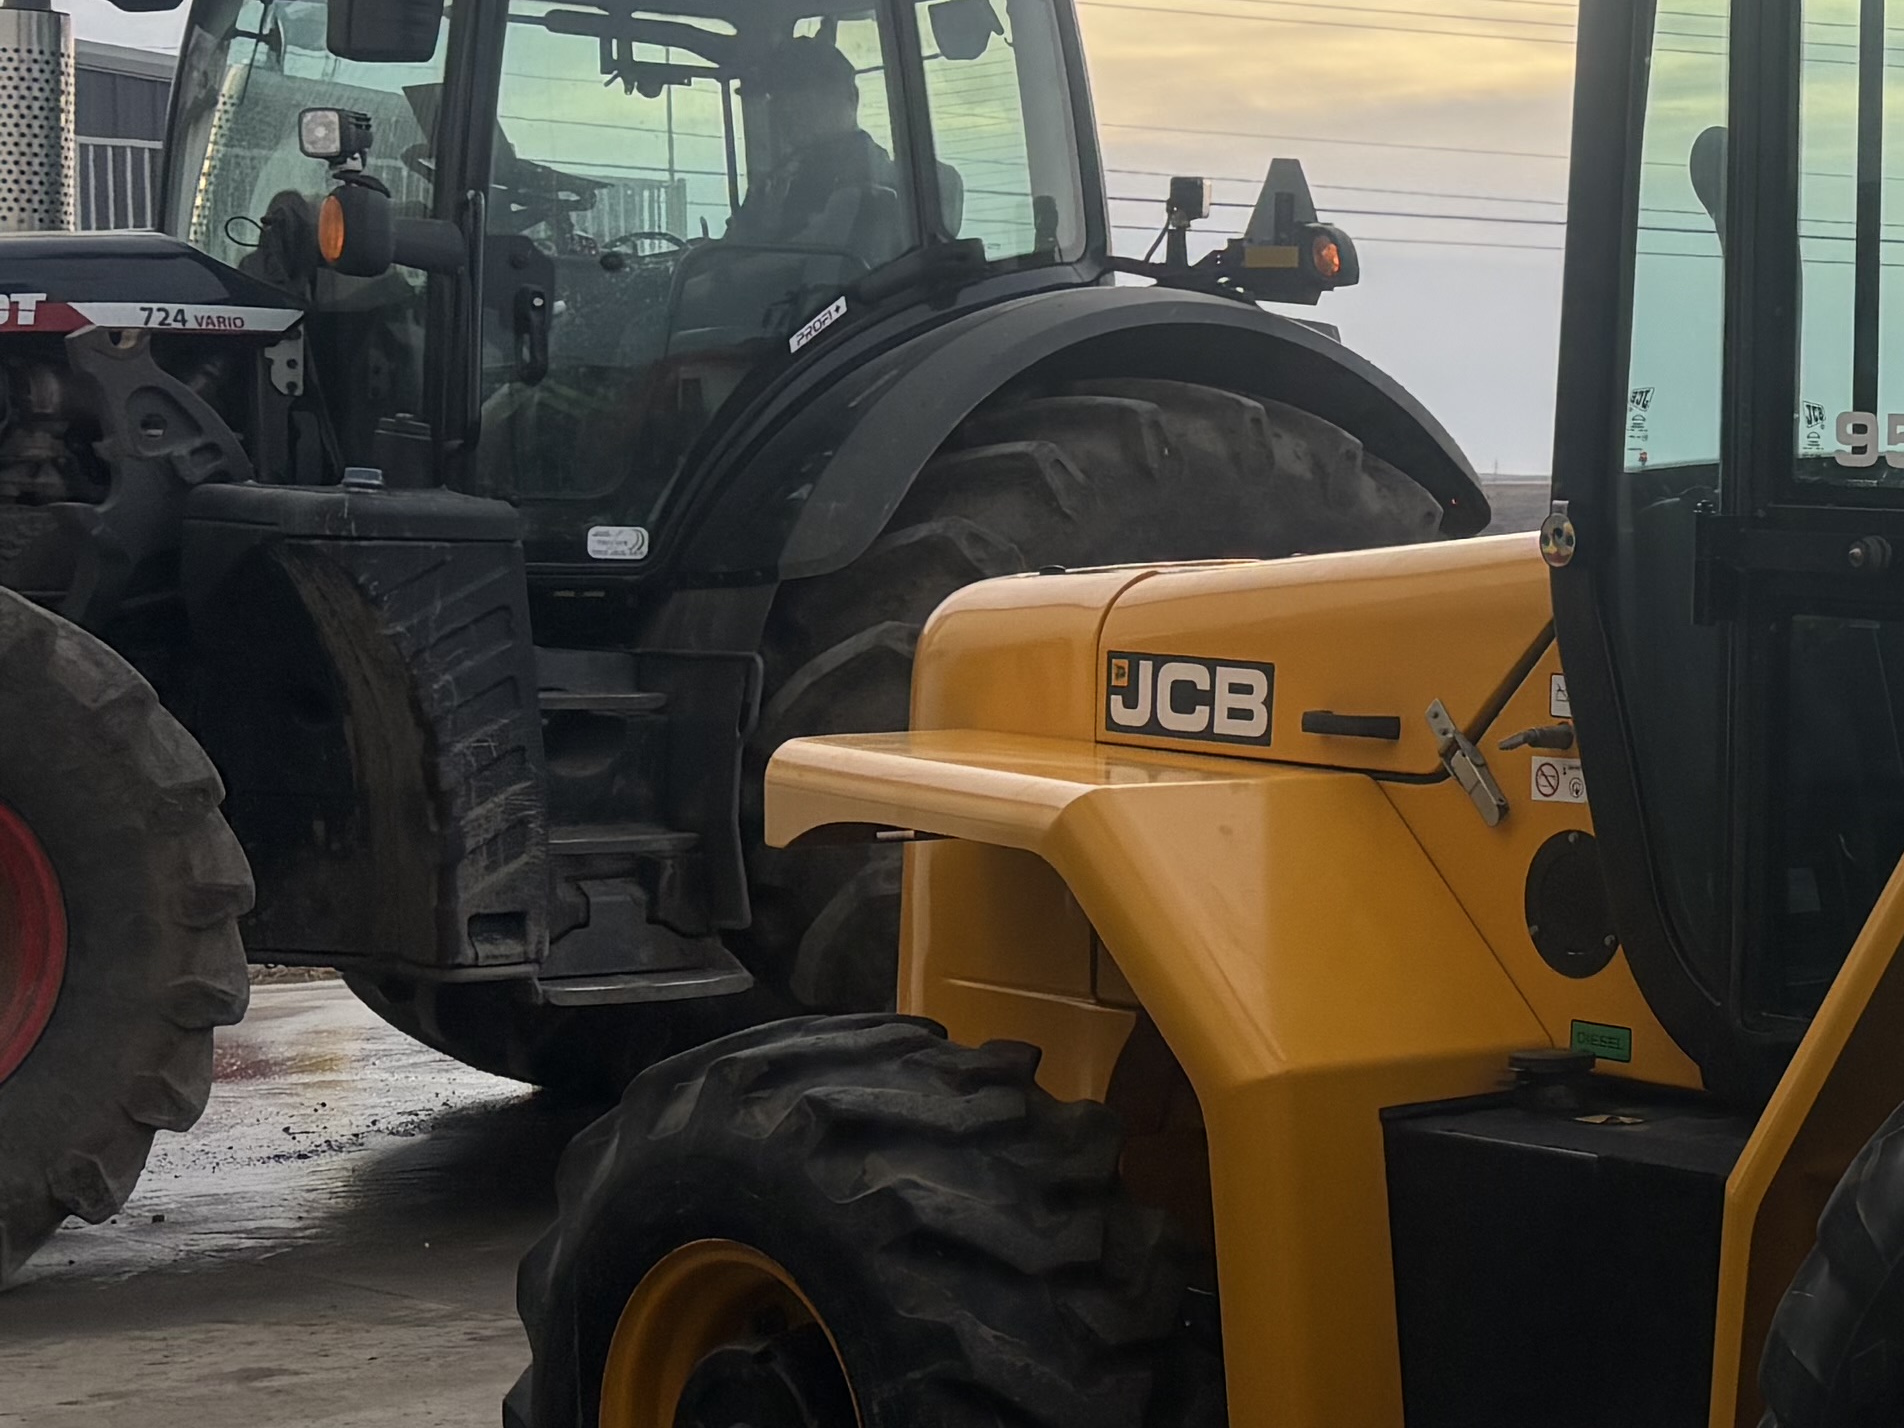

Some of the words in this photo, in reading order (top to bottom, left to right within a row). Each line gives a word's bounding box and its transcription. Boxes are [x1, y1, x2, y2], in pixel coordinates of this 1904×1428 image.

[139, 307, 188, 327] 724
[194, 314, 245, 329] VARIO
[1110, 660, 1268, 738] JCB
[1577, 1031, 1623, 1050] DIESEL
